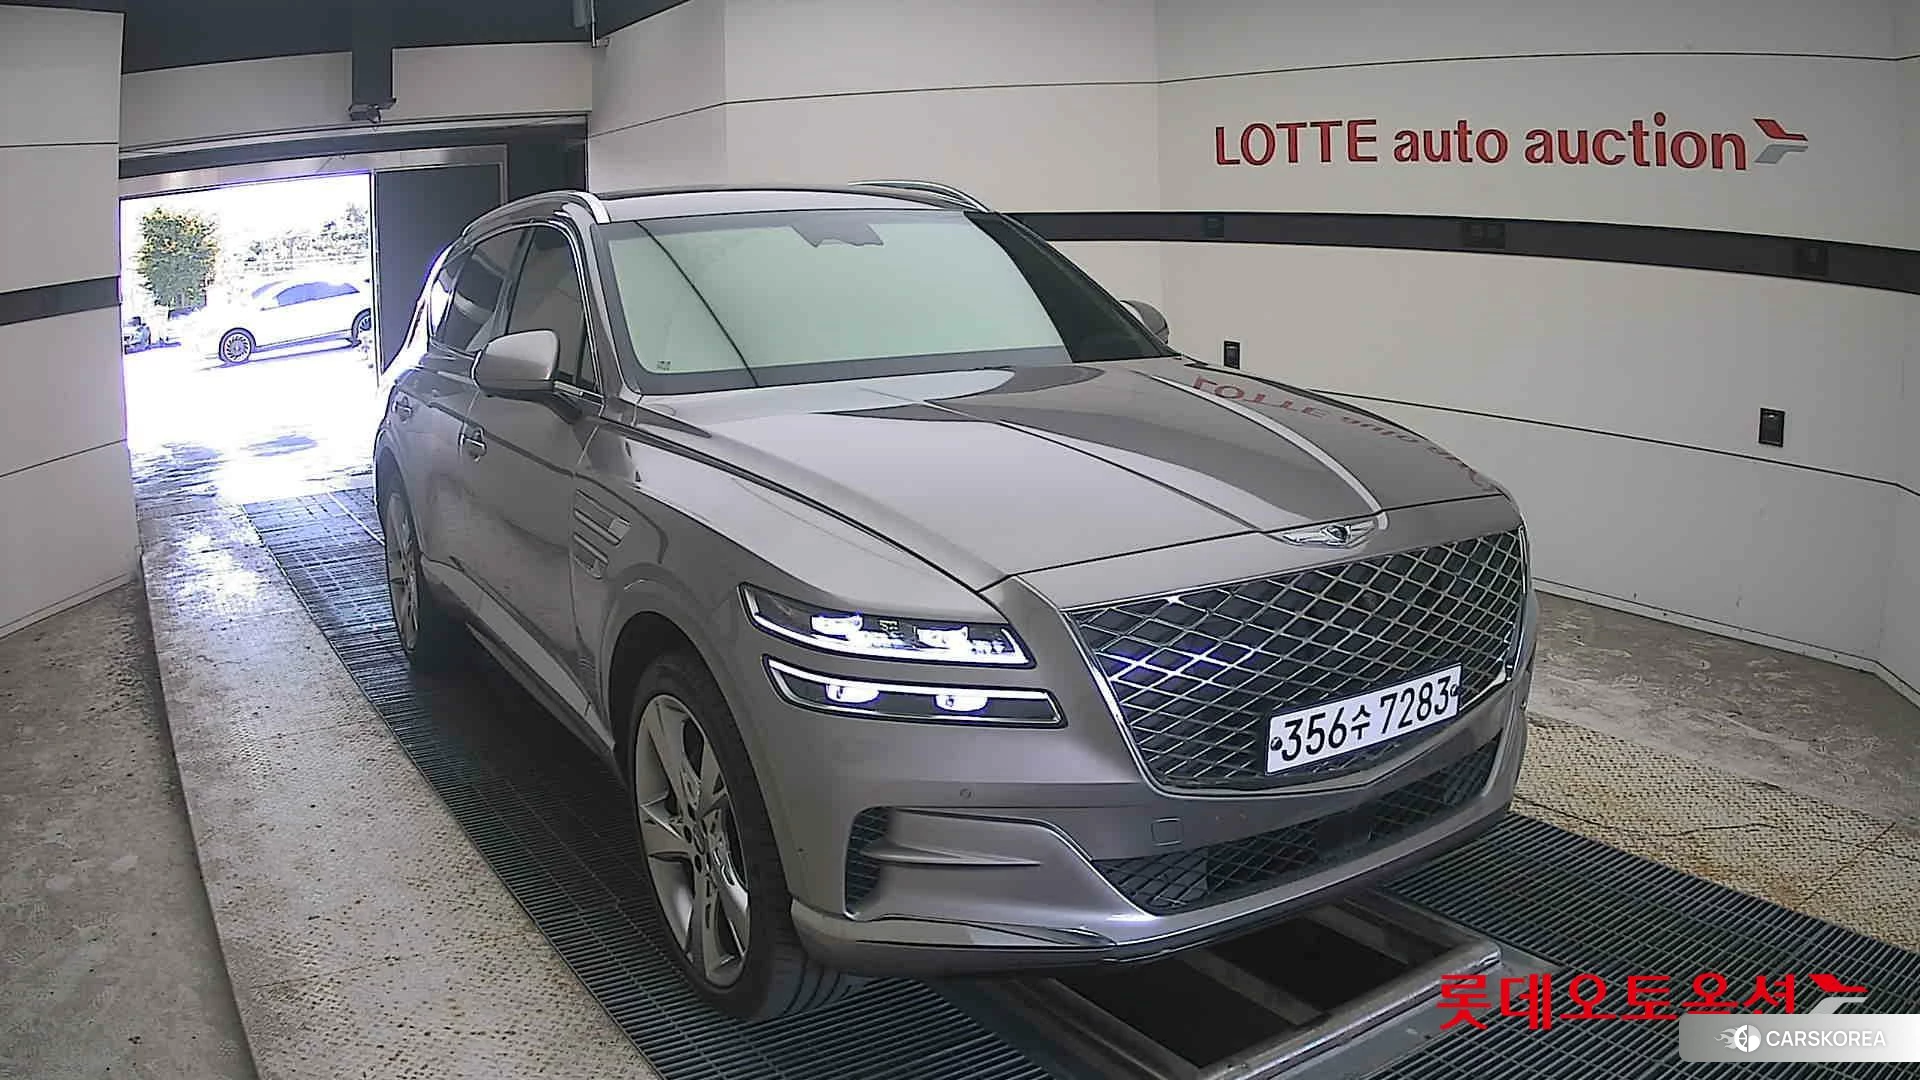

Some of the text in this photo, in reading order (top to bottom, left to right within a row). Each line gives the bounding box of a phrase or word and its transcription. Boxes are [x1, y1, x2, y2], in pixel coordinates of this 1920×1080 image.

[1215, 112, 1748, 171] LOTTE auto auction
[1281, 675, 1452, 761] 356수 7283
